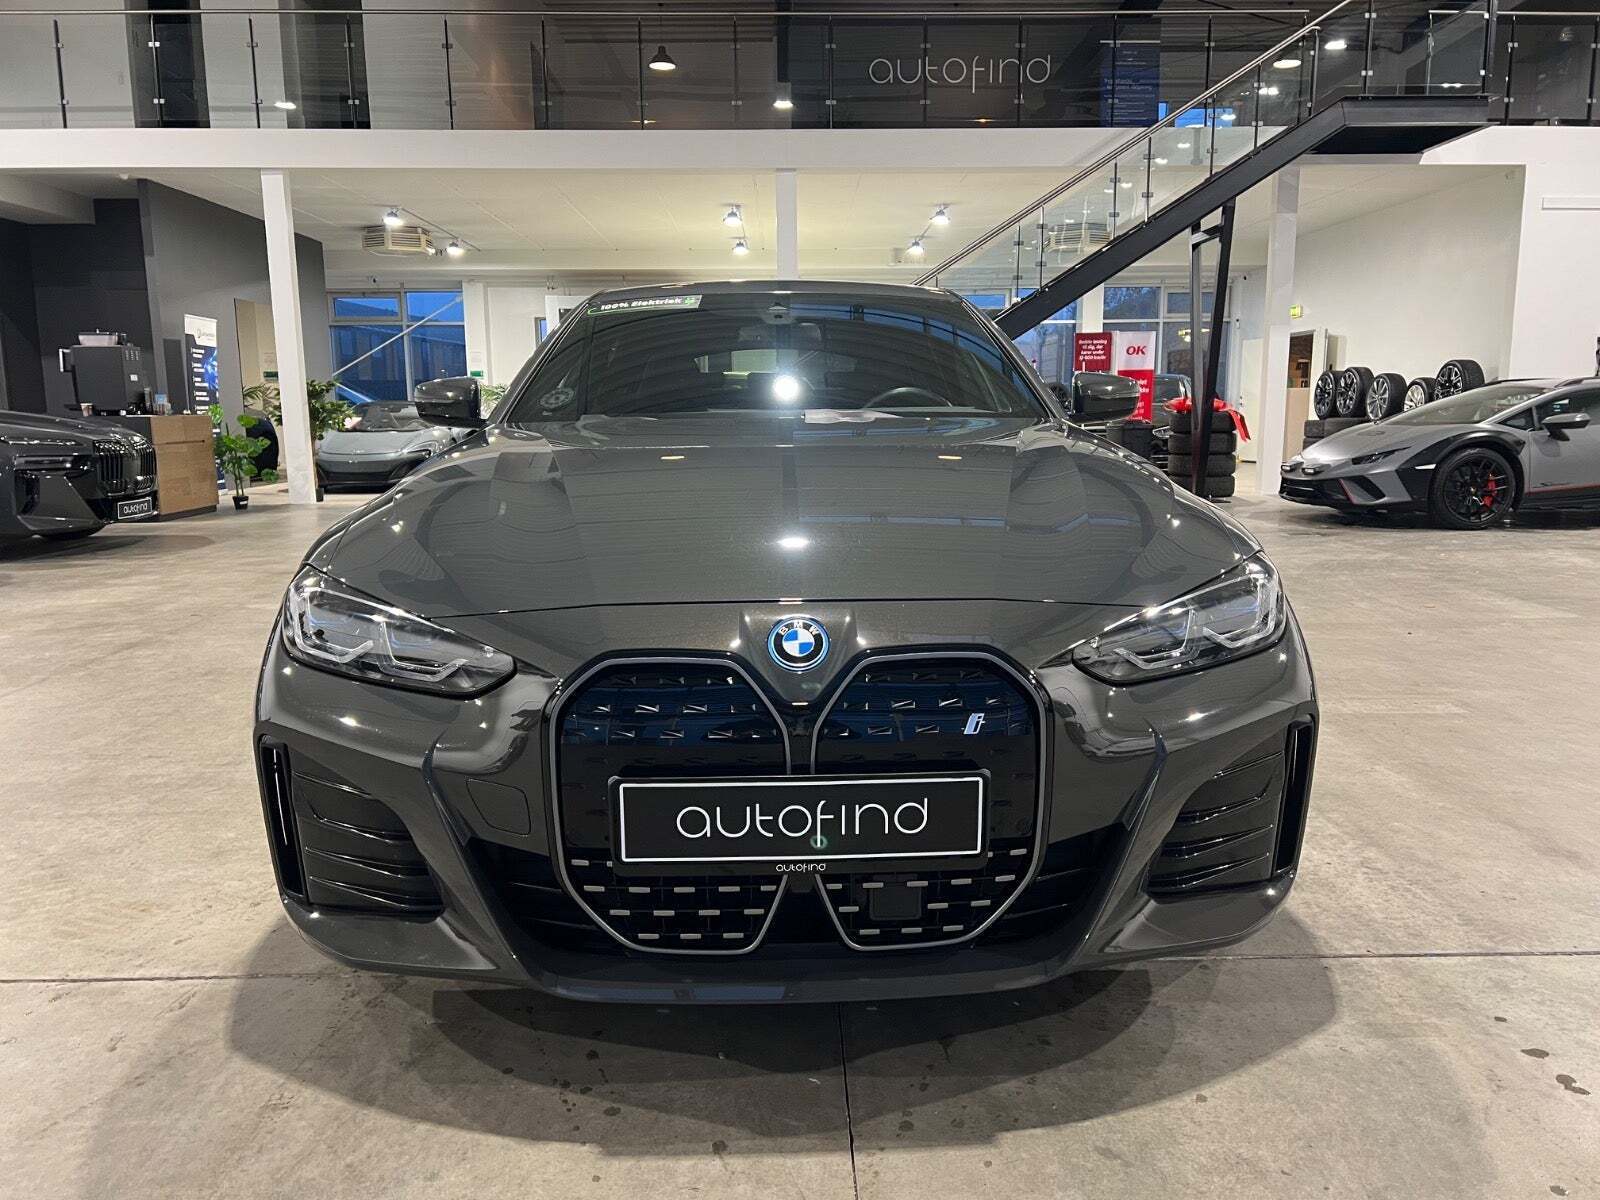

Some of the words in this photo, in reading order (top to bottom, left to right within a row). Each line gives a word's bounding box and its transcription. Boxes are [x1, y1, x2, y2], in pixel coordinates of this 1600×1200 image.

[869, 54, 1051, 94] autofind
[601, 302, 629, 311] 100%
[1126, 345, 1147, 356] OK
[778, 620, 820, 636] BMW
[676, 798, 928, 847] autofind
[775, 863, 826, 873] autofind
